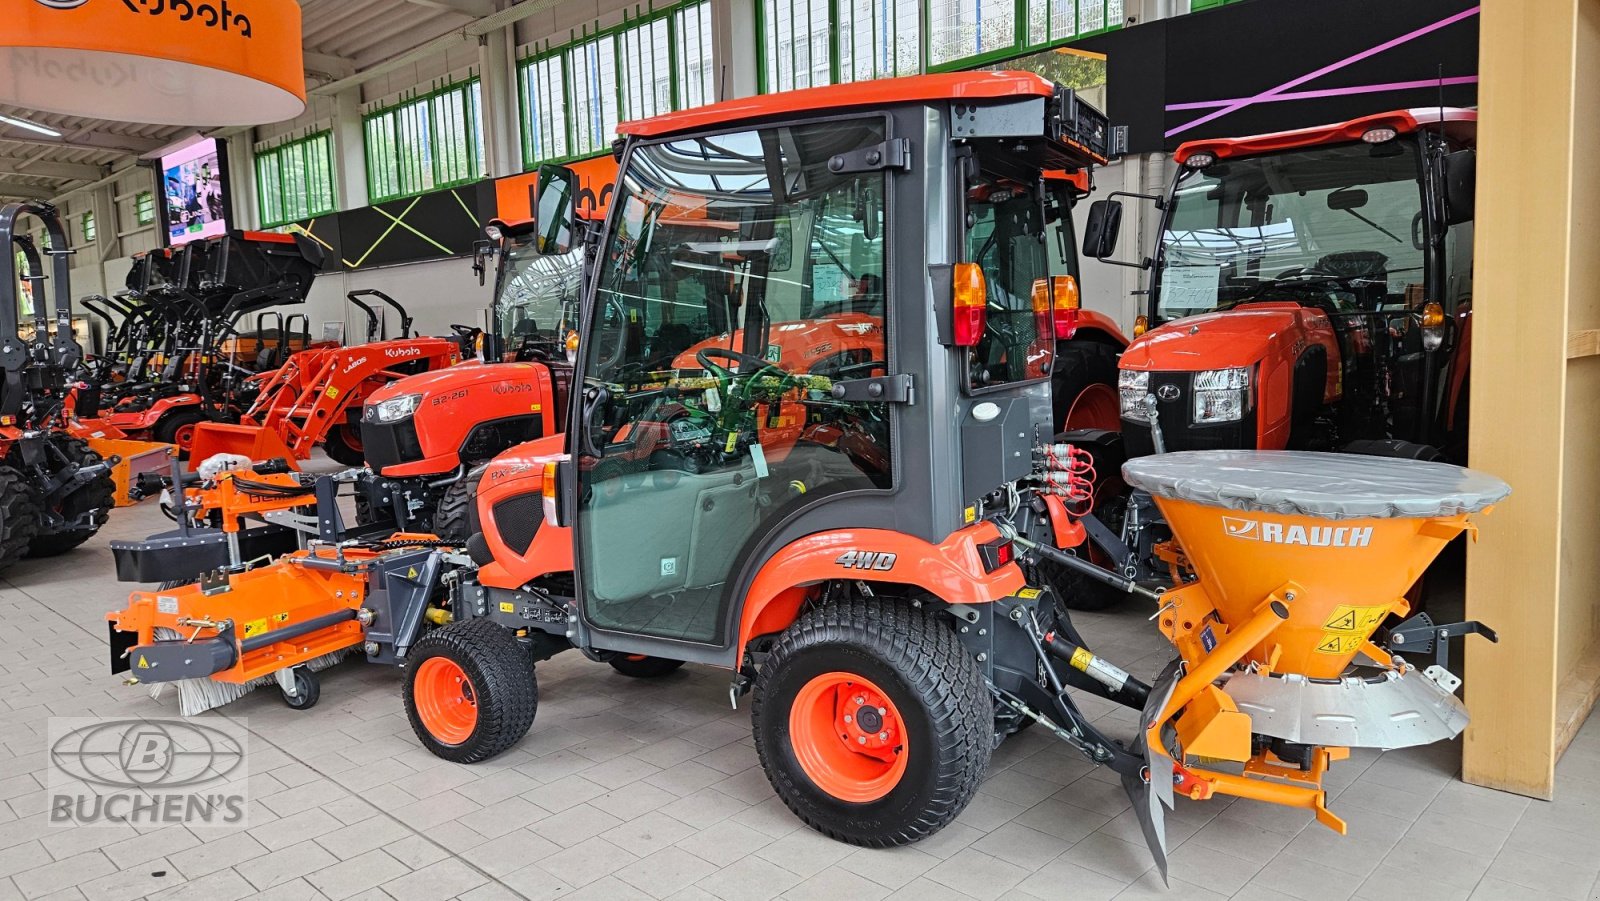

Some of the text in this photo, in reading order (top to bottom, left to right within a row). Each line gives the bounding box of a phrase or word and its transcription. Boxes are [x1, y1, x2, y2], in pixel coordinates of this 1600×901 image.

[385, 347, 420, 357] Kubota
[1262, 522, 1374, 547] RAUCH
[835, 550, 897, 571] 4WD
